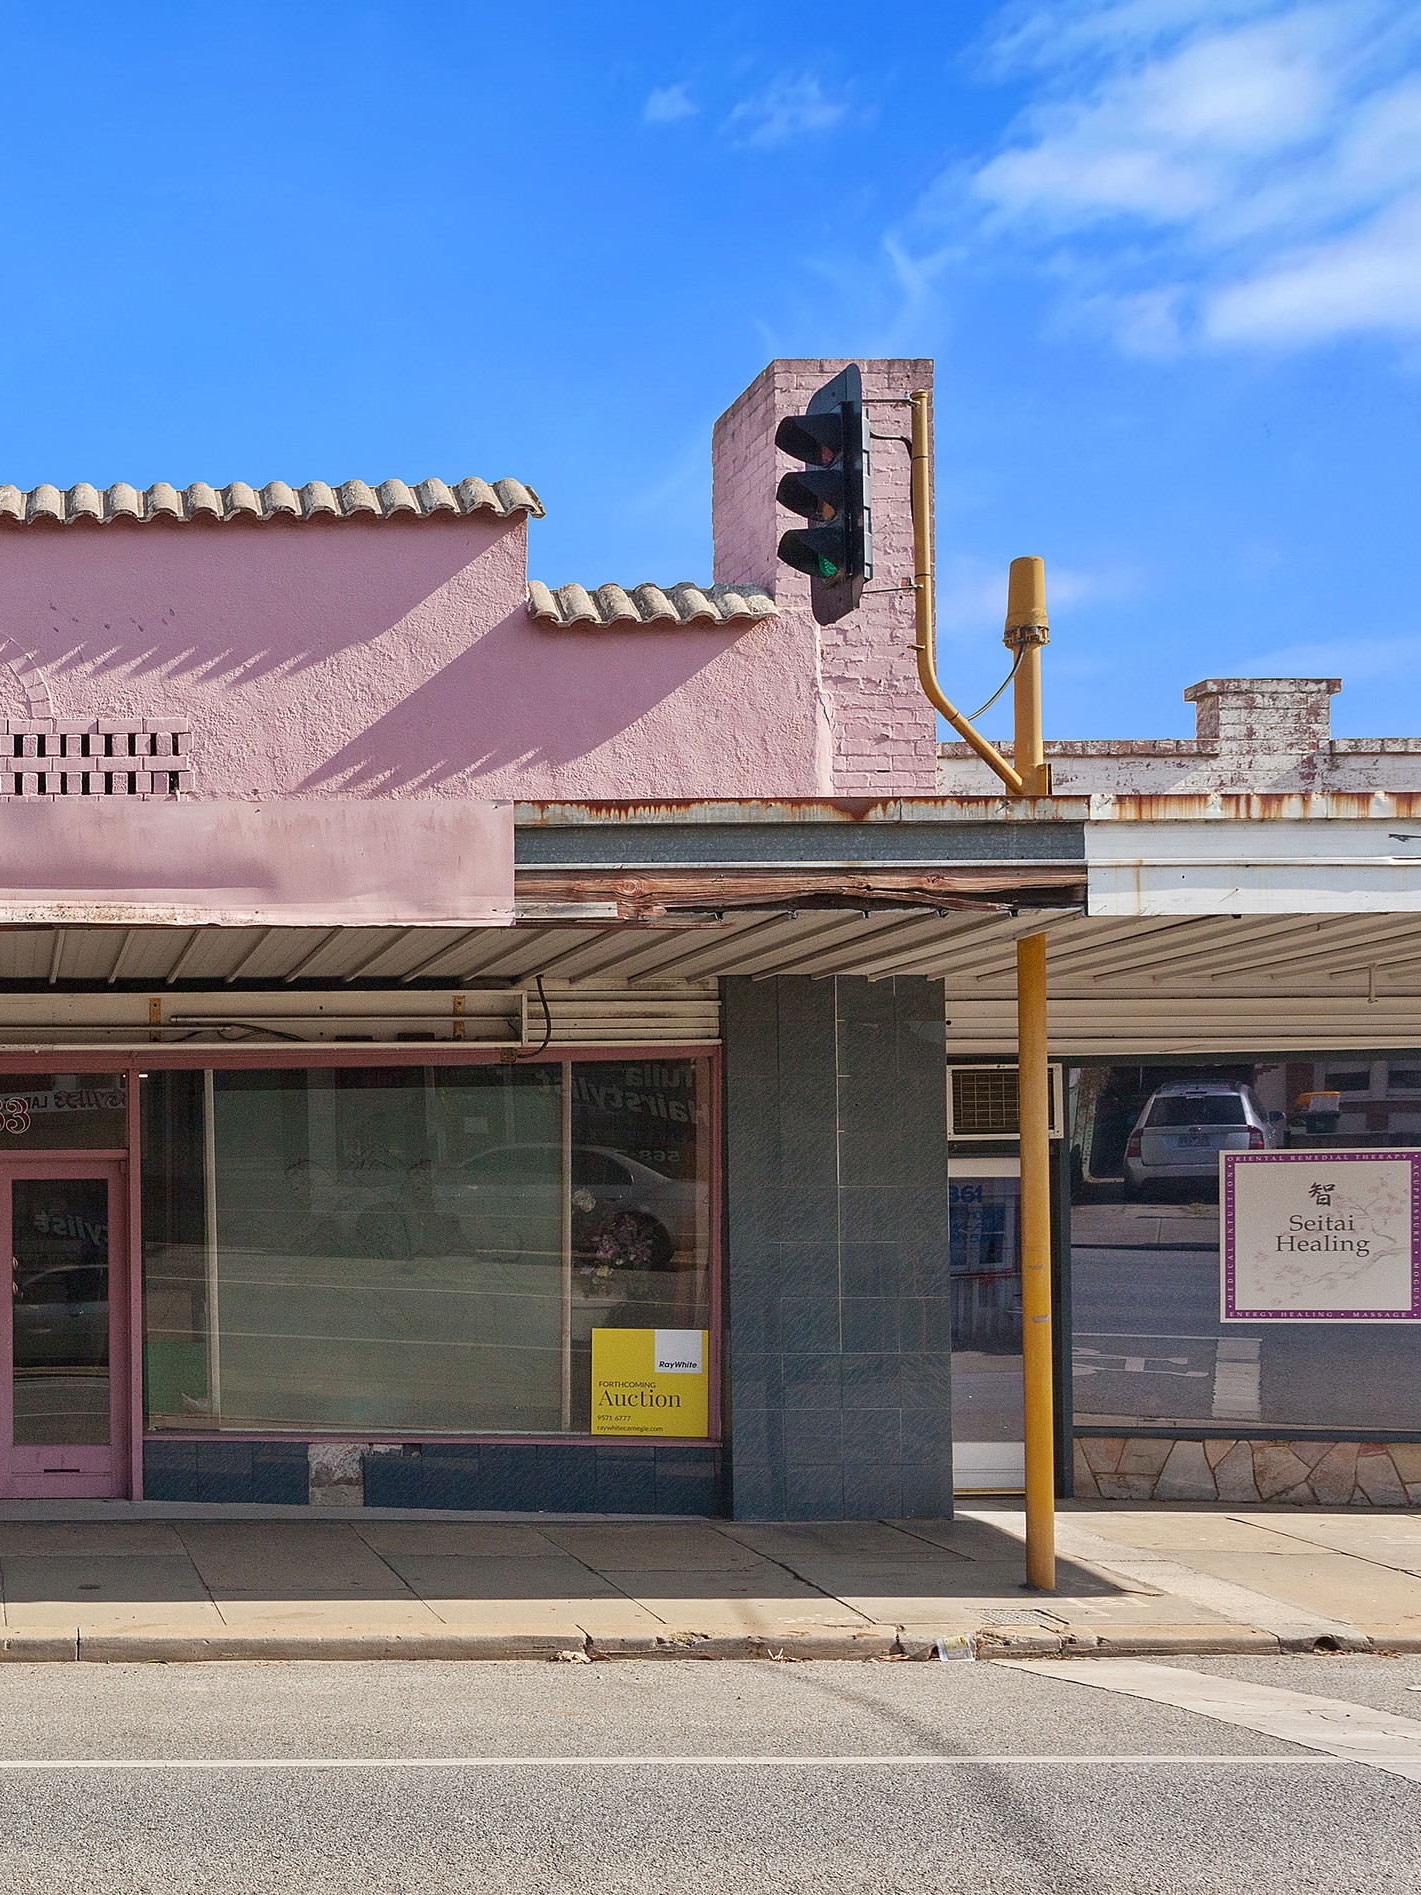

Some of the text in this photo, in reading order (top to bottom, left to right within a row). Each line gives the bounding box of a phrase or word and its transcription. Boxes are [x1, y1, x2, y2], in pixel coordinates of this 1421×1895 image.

[1308, 1182, 1336, 1207] 智
[1412, 1165, 1420, 1243] ACUPRESSURE
[1289, 1214, 1356, 1232] Seitai
[1276, 1234, 1371, 1258] Healing
[1412, 1263, 1420, 1308] MOGUSA
[659, 1361, 698, 1369] RayWhite
[598, 1389, 681, 1408] Auction
